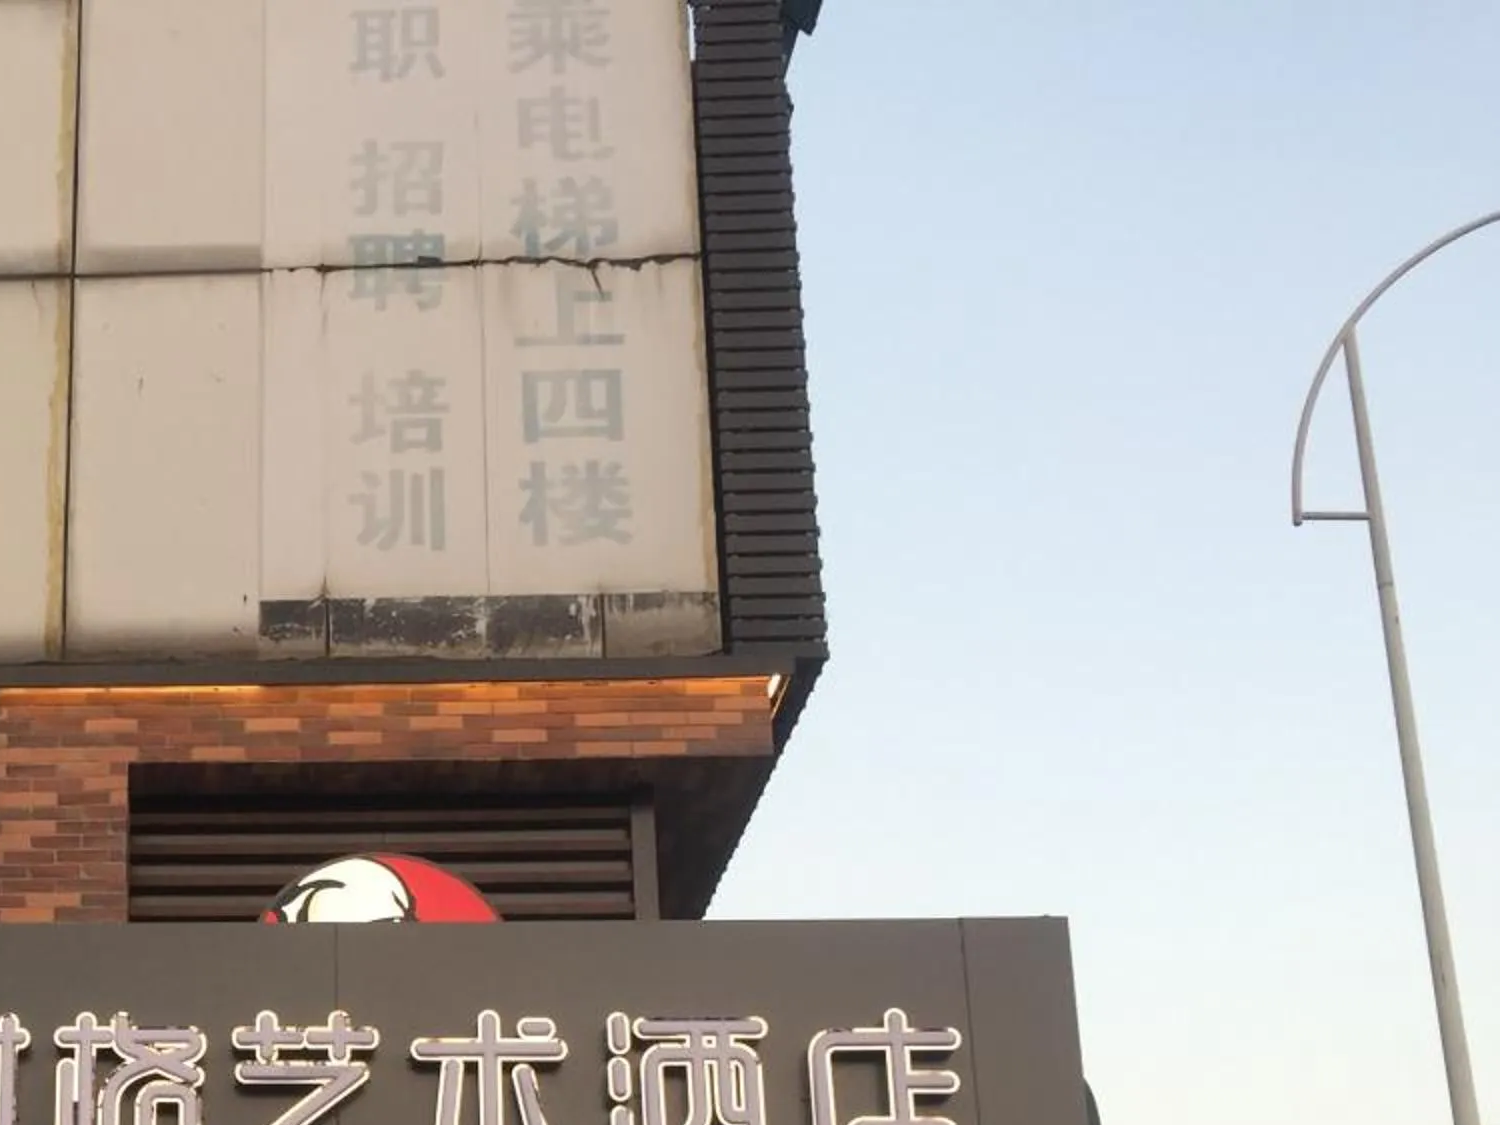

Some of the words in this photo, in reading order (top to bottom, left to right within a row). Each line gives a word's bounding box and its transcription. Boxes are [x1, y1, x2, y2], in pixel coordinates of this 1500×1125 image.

[506, 0, 635, 548] 乘电梯上四楼
